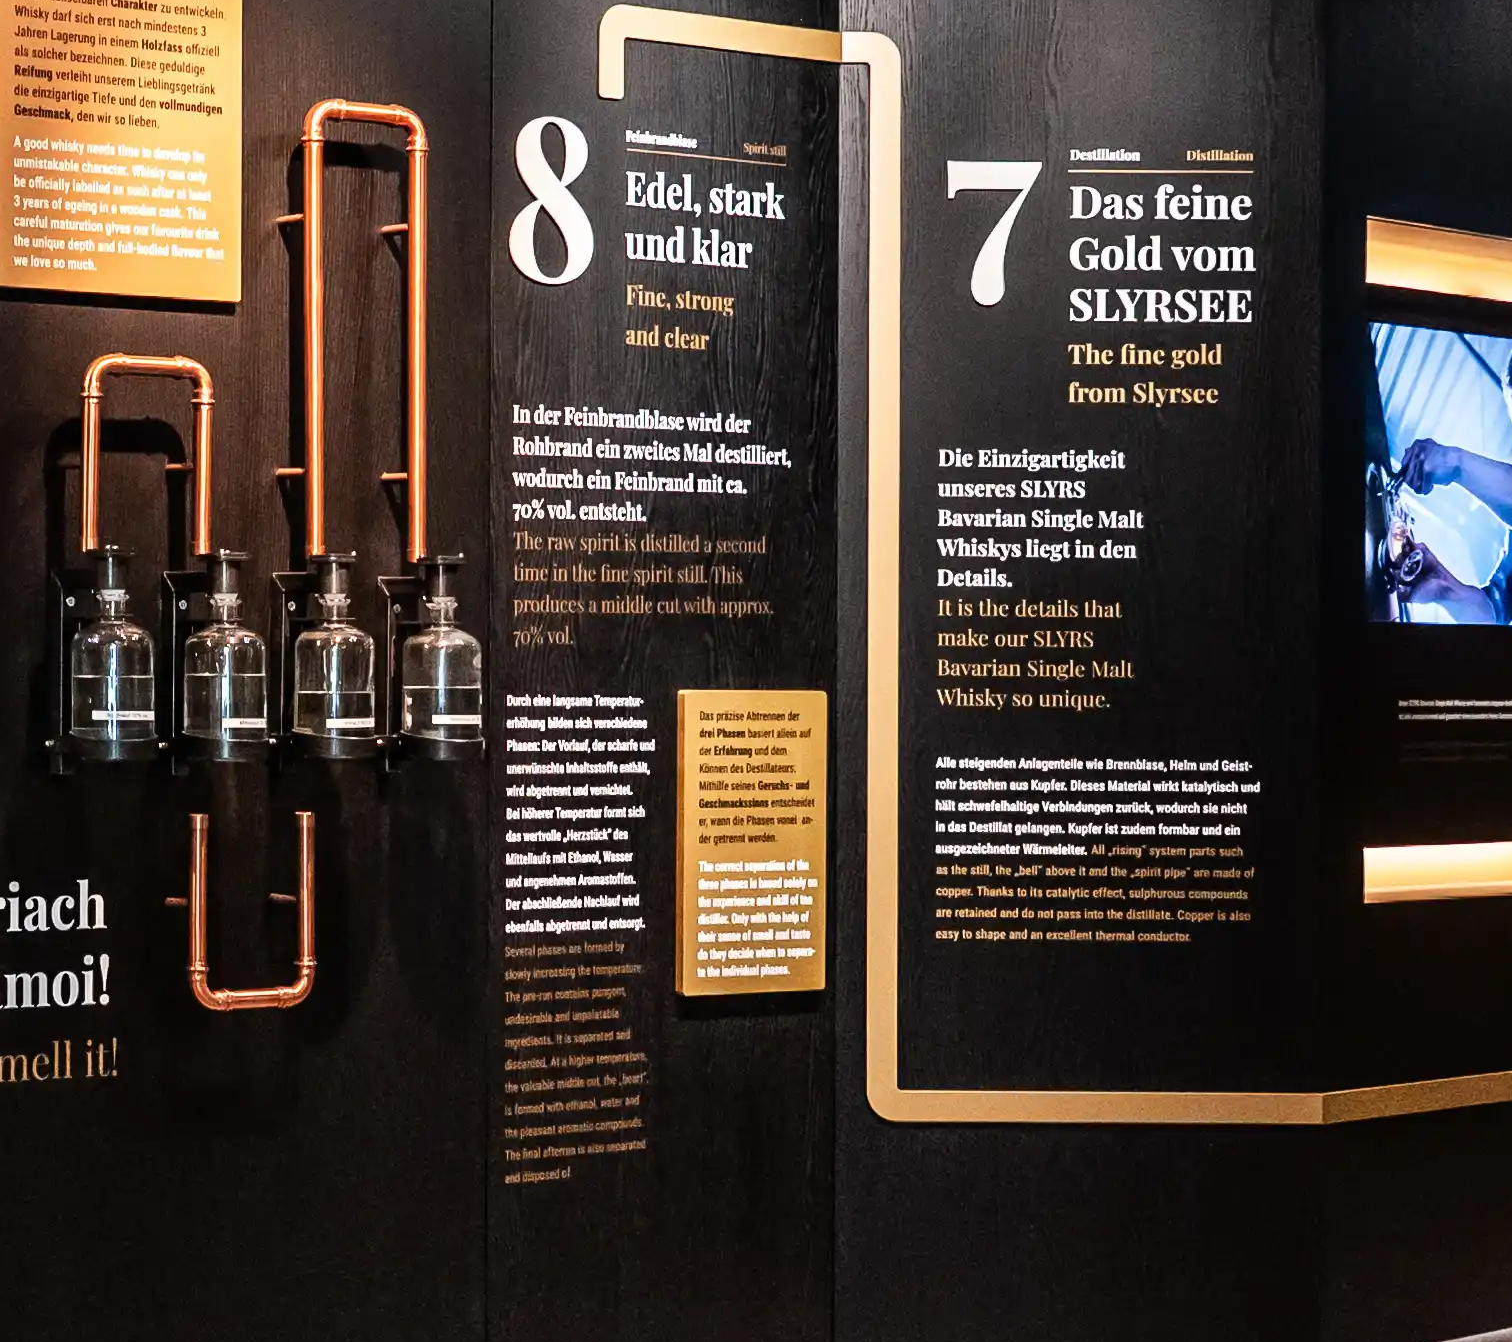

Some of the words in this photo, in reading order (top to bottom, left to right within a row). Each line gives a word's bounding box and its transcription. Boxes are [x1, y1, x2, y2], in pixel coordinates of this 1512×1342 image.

[14, 5, 49, 23] Whisky
[52, 9, 72, 22] darf
[75, 11, 94, 25] sich
[97, 15, 116, 27] erst
[118, 15, 142, 29] nach
[144, 19, 198, 35] mindestens
[201, 24, 207, 36] 3
[160, 4, 171, 14] zu
[174, 5, 227, 20] entwickeln.
[14, 24, 48, 39] Jahren
[50, 28, 96, 47] Lagerung
[98, 33, 107, 45] in
[110, 34, 139, 49] einem
[141, 37, 183, 53] Holzfass
[185, 42, 220, 57] offiziell
[14, 44, 29, 57] als
[32, 47, 68, 61] solcher
[70, 50, 127, 67] bezeichnen.
[130, 56, 157, 70] Diese
[159, 59, 205, 76] geduldige
[14, 64, 53, 82] Reifung
[55, 68, 92, 83] verleiht
[94, 75, 136, 87] unserem
[138, 76, 216, 95] Lieblingsgetränk
[14, 84, 29, 97] die
[32, 86, 89, 103] einzigartige
[92, 91, 116, 105] Tiefe
[119, 94, 137, 107] und
[139, 95, 156, 109] den
[159, 97, 223, 116] vollmundigen
[14, 104, 74, 123] Geschmack,
[76, 109, 94, 123] den
[97, 111, 111, 124] wir
[114, 116, 126, 125] so
[128, 114, 160, 129] lieben.
[744, 143, 768, 156] Spirit
[770, 145, 786, 156] still
[1070, 149, 1140, 161] Destillation
[1186, 150, 1254, 161] Distillation
[508, 116, 595, 285] 8
[625, 171, 701, 217] Edel,
[709, 182, 785, 219] stark
[1070, 186, 1144, 220] Das
[1154, 184, 1252, 220] feine
[947, 160, 1042, 306] 7
[625, 226, 685, 264] und
[692, 228, 752, 269] klar
[1069, 235, 1162, 271] Gold
[1171, 245, 1256, 271] vom
[626, 284, 671, 310] Fine,
[676, 289, 734, 317] strong
[1069, 289, 1252, 323] SLYRSEE
[625, 325, 659, 347] and
[664, 327, 709, 350] clear
[1068, 343, 1114, 365] The
[1120, 343, 1165, 365] fine
[1171, 344, 1222, 369] gold
[1068, 381, 1125, 403] from
[1133, 382, 1218, 407] Slyrsee
[513, 404, 530, 424] In
[534, 405, 561, 425] der
[564, 407, 684, 431] Feinbrandblase
[686, 412, 722, 433] wird
[725, 414, 751, 434] der
[513, 436, 592, 458] Rohbrand
[596, 440, 620, 459] ein
[623, 441, 680, 461] zweites
[683, 443, 712, 463] Mal
[715, 445, 791, 468] destilliert,
[938, 449, 973, 468] Die
[978, 450, 1126, 472] Einzigartigkeit
[513, 468, 583, 489] wodurch
[587, 471, 611, 490] ein
[615, 471, 694, 492] Feinbrand
[697, 473, 723, 493] mit
[726, 478, 747, 494] ca.
[938, 482, 1016, 498] unseres
[1020, 480, 1086, 498] SLYRS
[513, 498, 544, 522] 70%
[547, 502, 576, 520] vol.
[579, 503, 646, 522] entsteht.
[938, 509, 1026, 528] Bavarian
[1031, 510, 1094, 531] Single
[1098, 511, 1144, 529] Malt
[937, 538, 1021, 561] Whiskys
[1026, 539, 1070, 561] liegt
[1075, 540, 1094, 558] in
[1100, 540, 1137, 558] den
[937, 568, 1013, 588] Details.
[938, 599, 952, 617] It
[958, 599, 973, 617] is
[979, 599, 1009, 617] the
[1015, 600, 1078, 618] details
[1084, 600, 1122, 618] that
[548, 626, 574, 645] vol.
[937, 628, 988, 647] make
[995, 633, 1028, 647] our
[1033, 631, 1094, 648] SLYRS
[937, 659, 1020, 677] Bavarian
[1027, 660, 1085, 681] Single
[1092, 661, 1135, 679] Malt
[936, 689, 1007, 710] Whisky
[1012, 693, 1033, 707] so
[1039, 690, 1110, 711] unique.
[86, 1037, 119, 1078] it!
